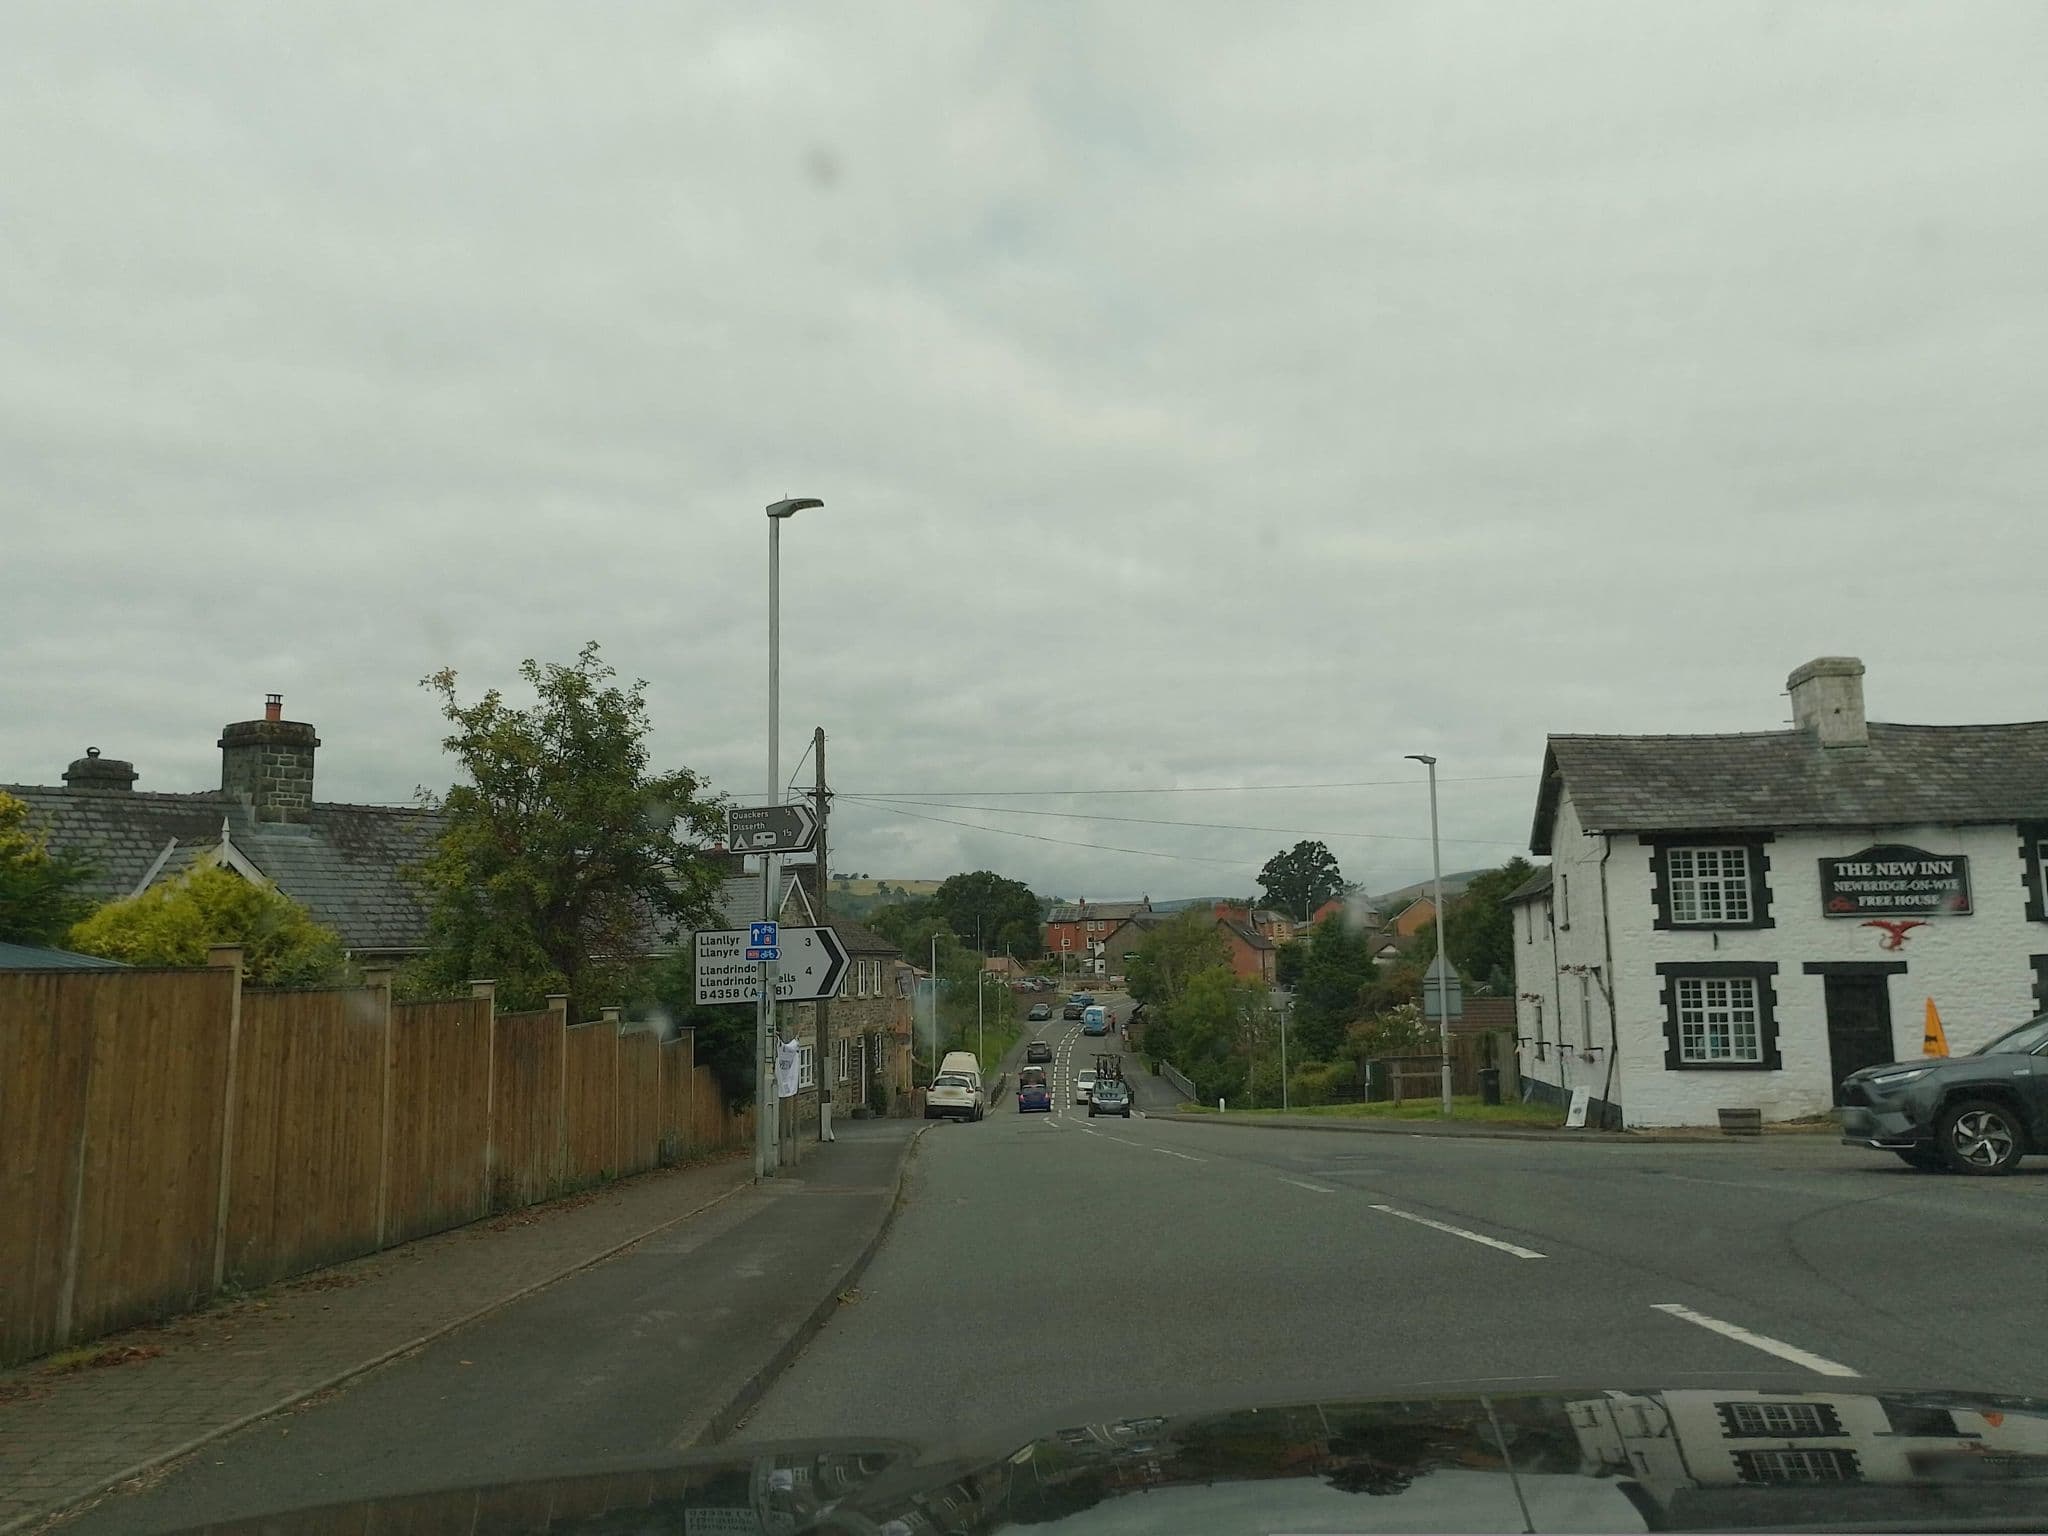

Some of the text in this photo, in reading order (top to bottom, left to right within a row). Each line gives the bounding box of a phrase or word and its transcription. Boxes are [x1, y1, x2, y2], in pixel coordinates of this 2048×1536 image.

[732, 811, 769, 820] Quackers
[732, 822, 765, 831] Disserth
[1834, 860, 1953, 876] THE NEW INN
[1834, 878, 1960, 892] NEWBRIDGE-ON-WYE
[1858, 894, 1940, 906] FREE HOUSE
[700, 935, 740, 946] Llanllyr
[805, 937, 811, 947] 3
[700, 948, 740, 958] Llanyre
[700, 965, 757, 975] Llandrindo
[805, 966, 812, 975] 4
[700, 973, 796, 987] Llandrindo ells
[700, 985, 793, 999] B4358 (A81)
